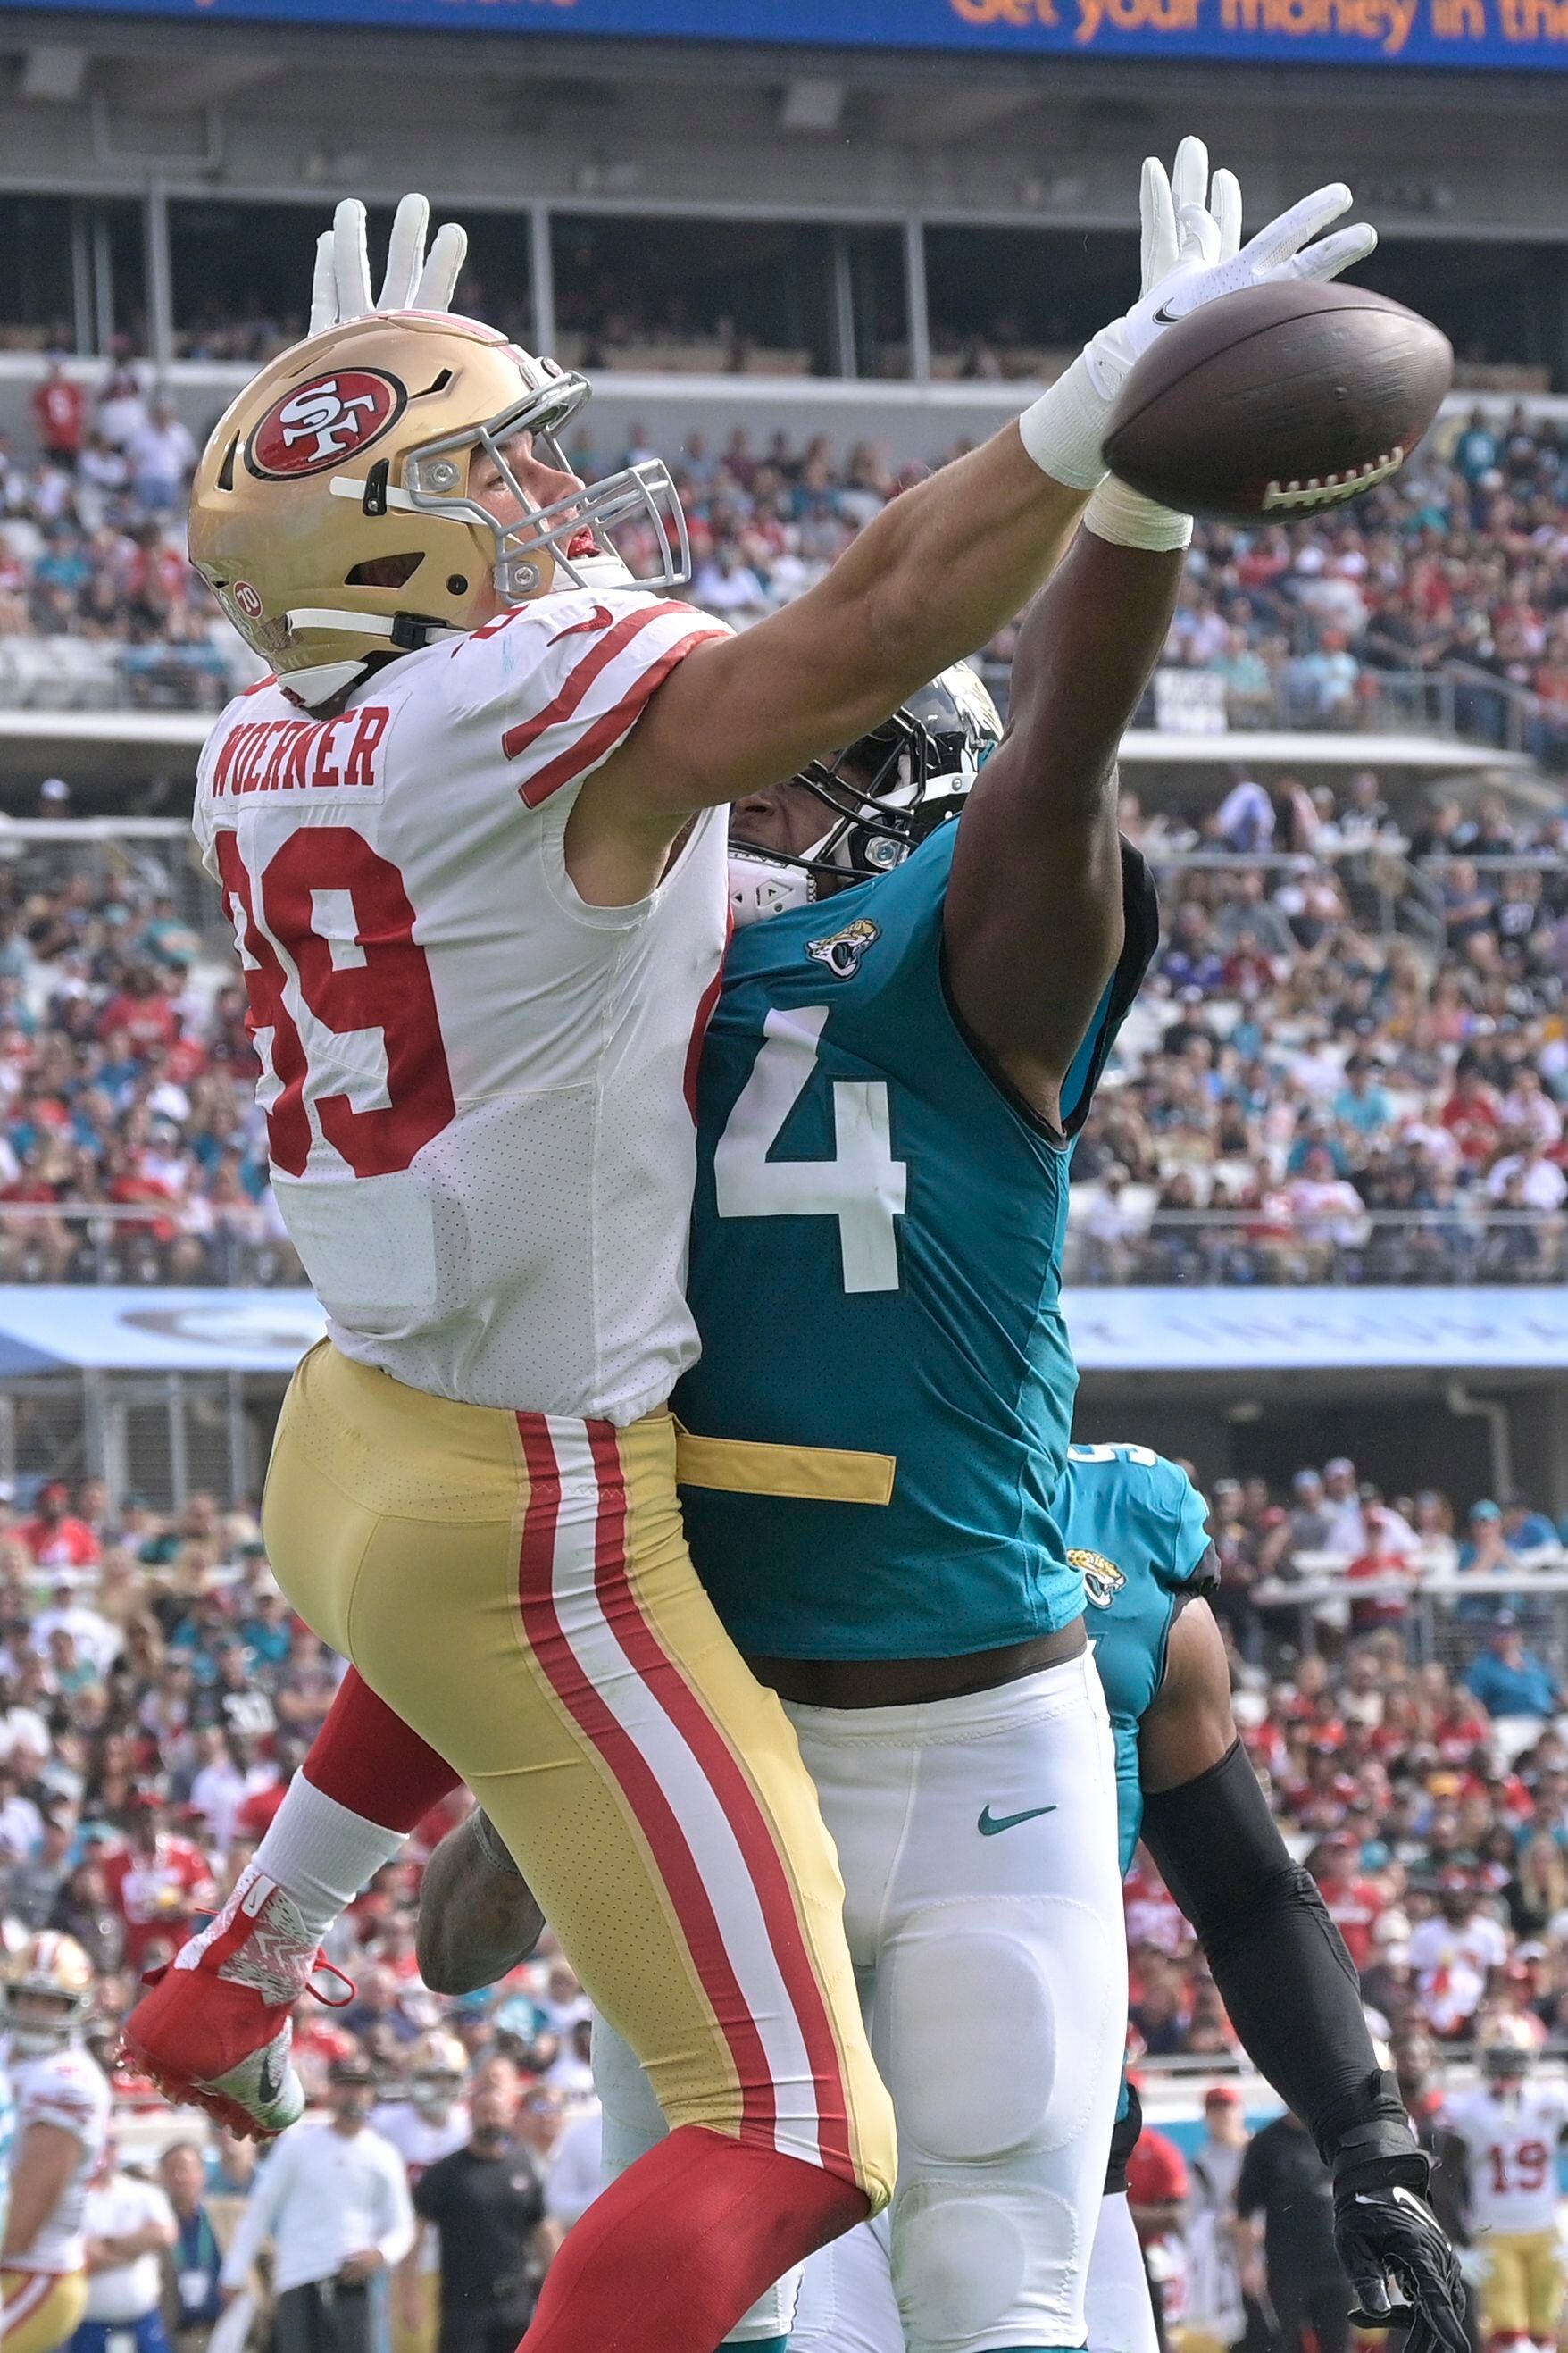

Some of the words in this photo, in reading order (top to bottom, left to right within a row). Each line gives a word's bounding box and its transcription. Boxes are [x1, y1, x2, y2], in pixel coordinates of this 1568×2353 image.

[1074, 0, 1198, 45] your
[1221, 0, 1418, 55] money
[1431, 0, 1486, 39] in
[279, 380, 375, 463] SF
[236, 586, 260, 613] 70
[1489, 2142, 1548, 2194] 19
